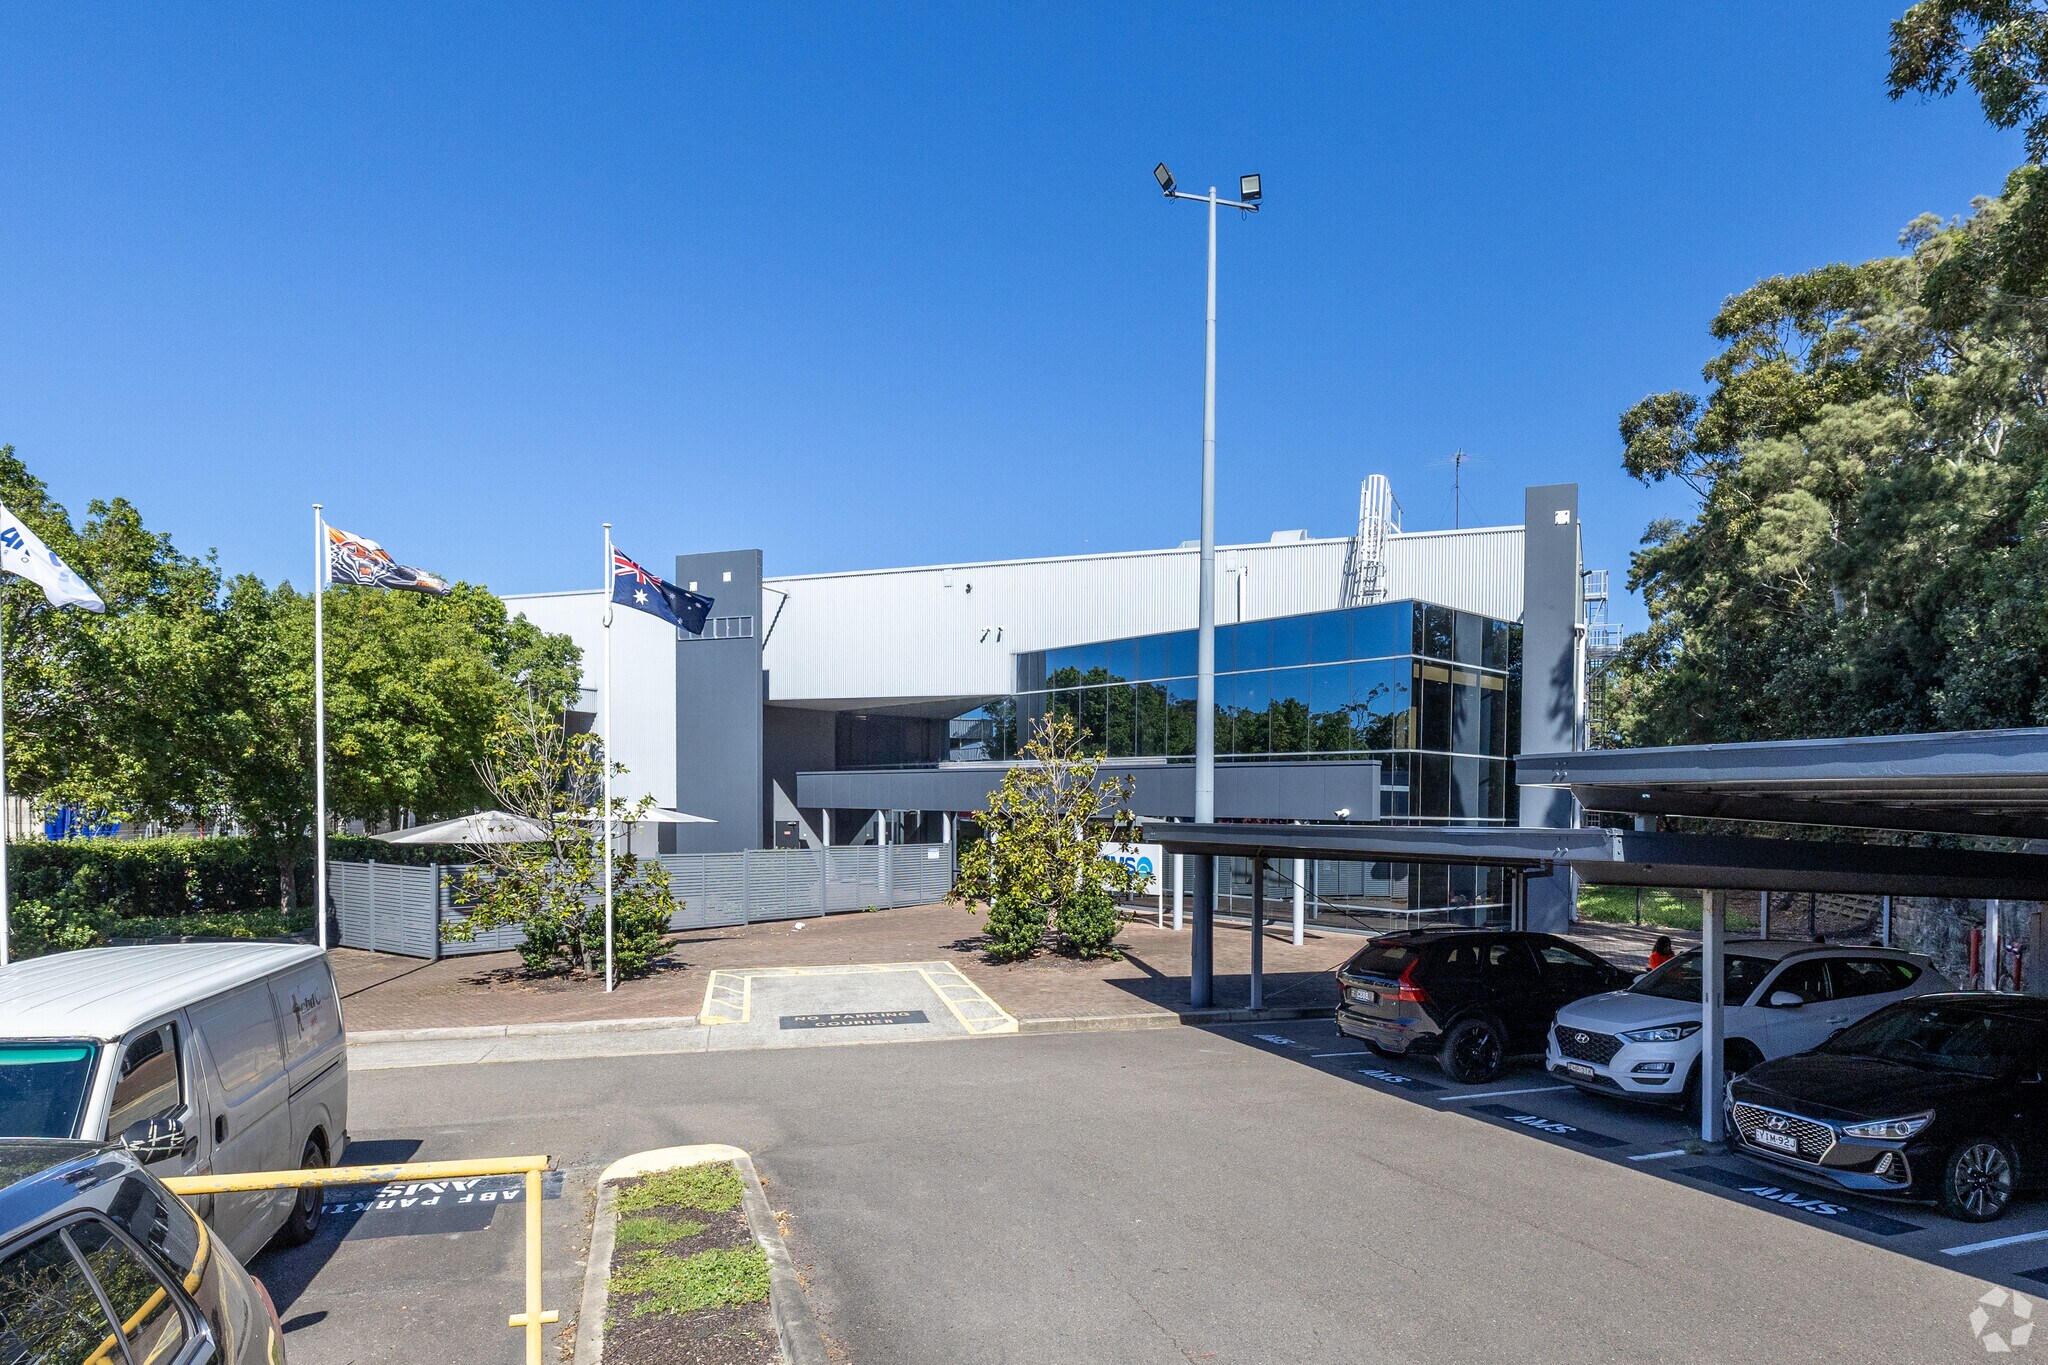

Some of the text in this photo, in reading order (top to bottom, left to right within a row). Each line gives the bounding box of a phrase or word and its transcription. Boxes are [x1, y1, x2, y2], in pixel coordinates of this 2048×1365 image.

[830, 1011, 911, 1020] PARKING
[815, 1019, 894, 1027] COURIER
[322, 1195, 441, 1214] PARKI
[1739, 1186, 1839, 1215] AMS
